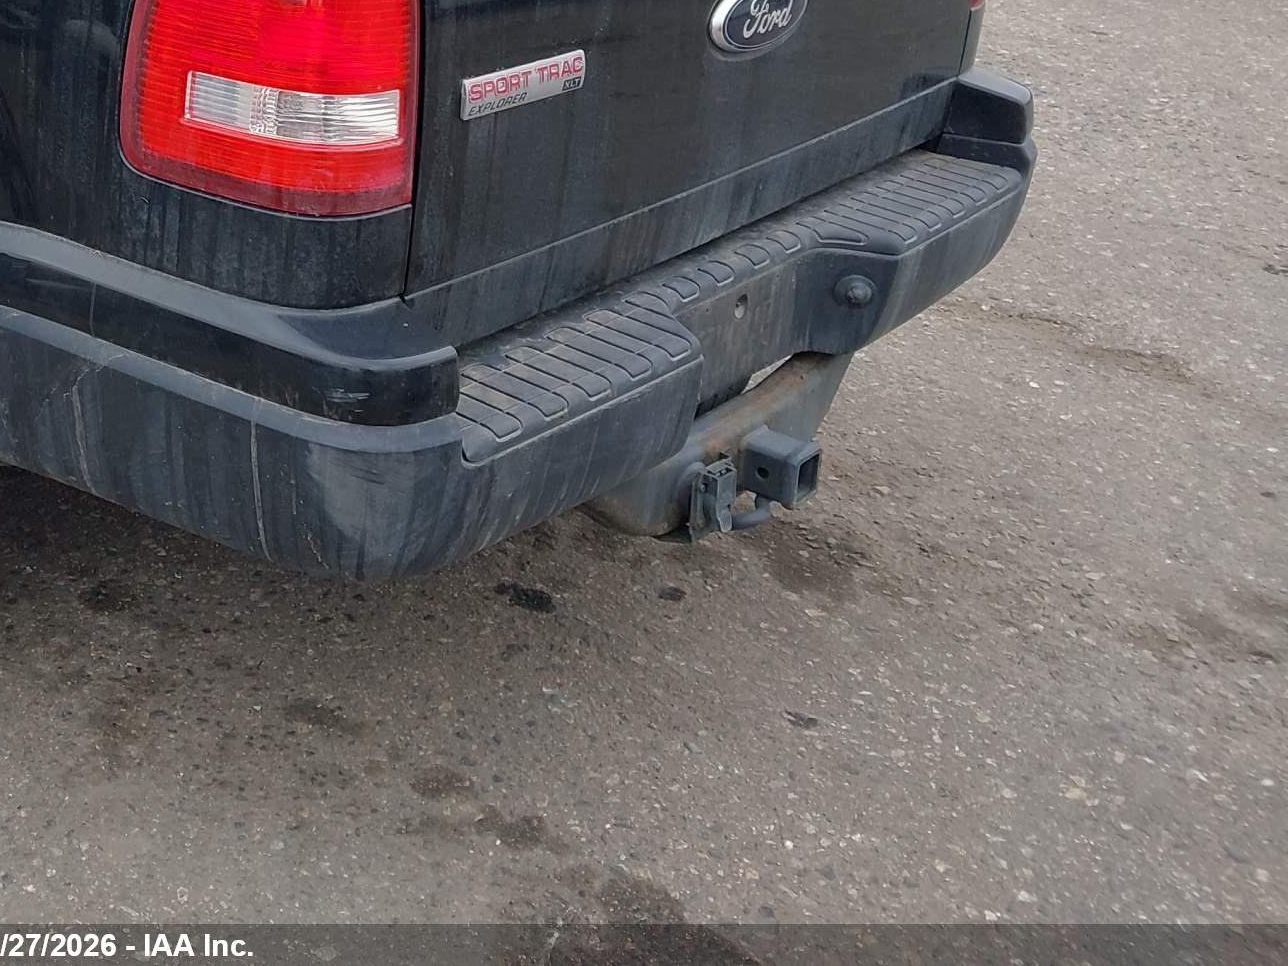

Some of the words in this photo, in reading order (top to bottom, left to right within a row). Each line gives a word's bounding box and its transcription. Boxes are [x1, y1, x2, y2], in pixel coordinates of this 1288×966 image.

[469, 70, 532, 103] SPORT
[535, 56, 584, 83] TRAC
[468, 92, 528, 116] EXPLORER
